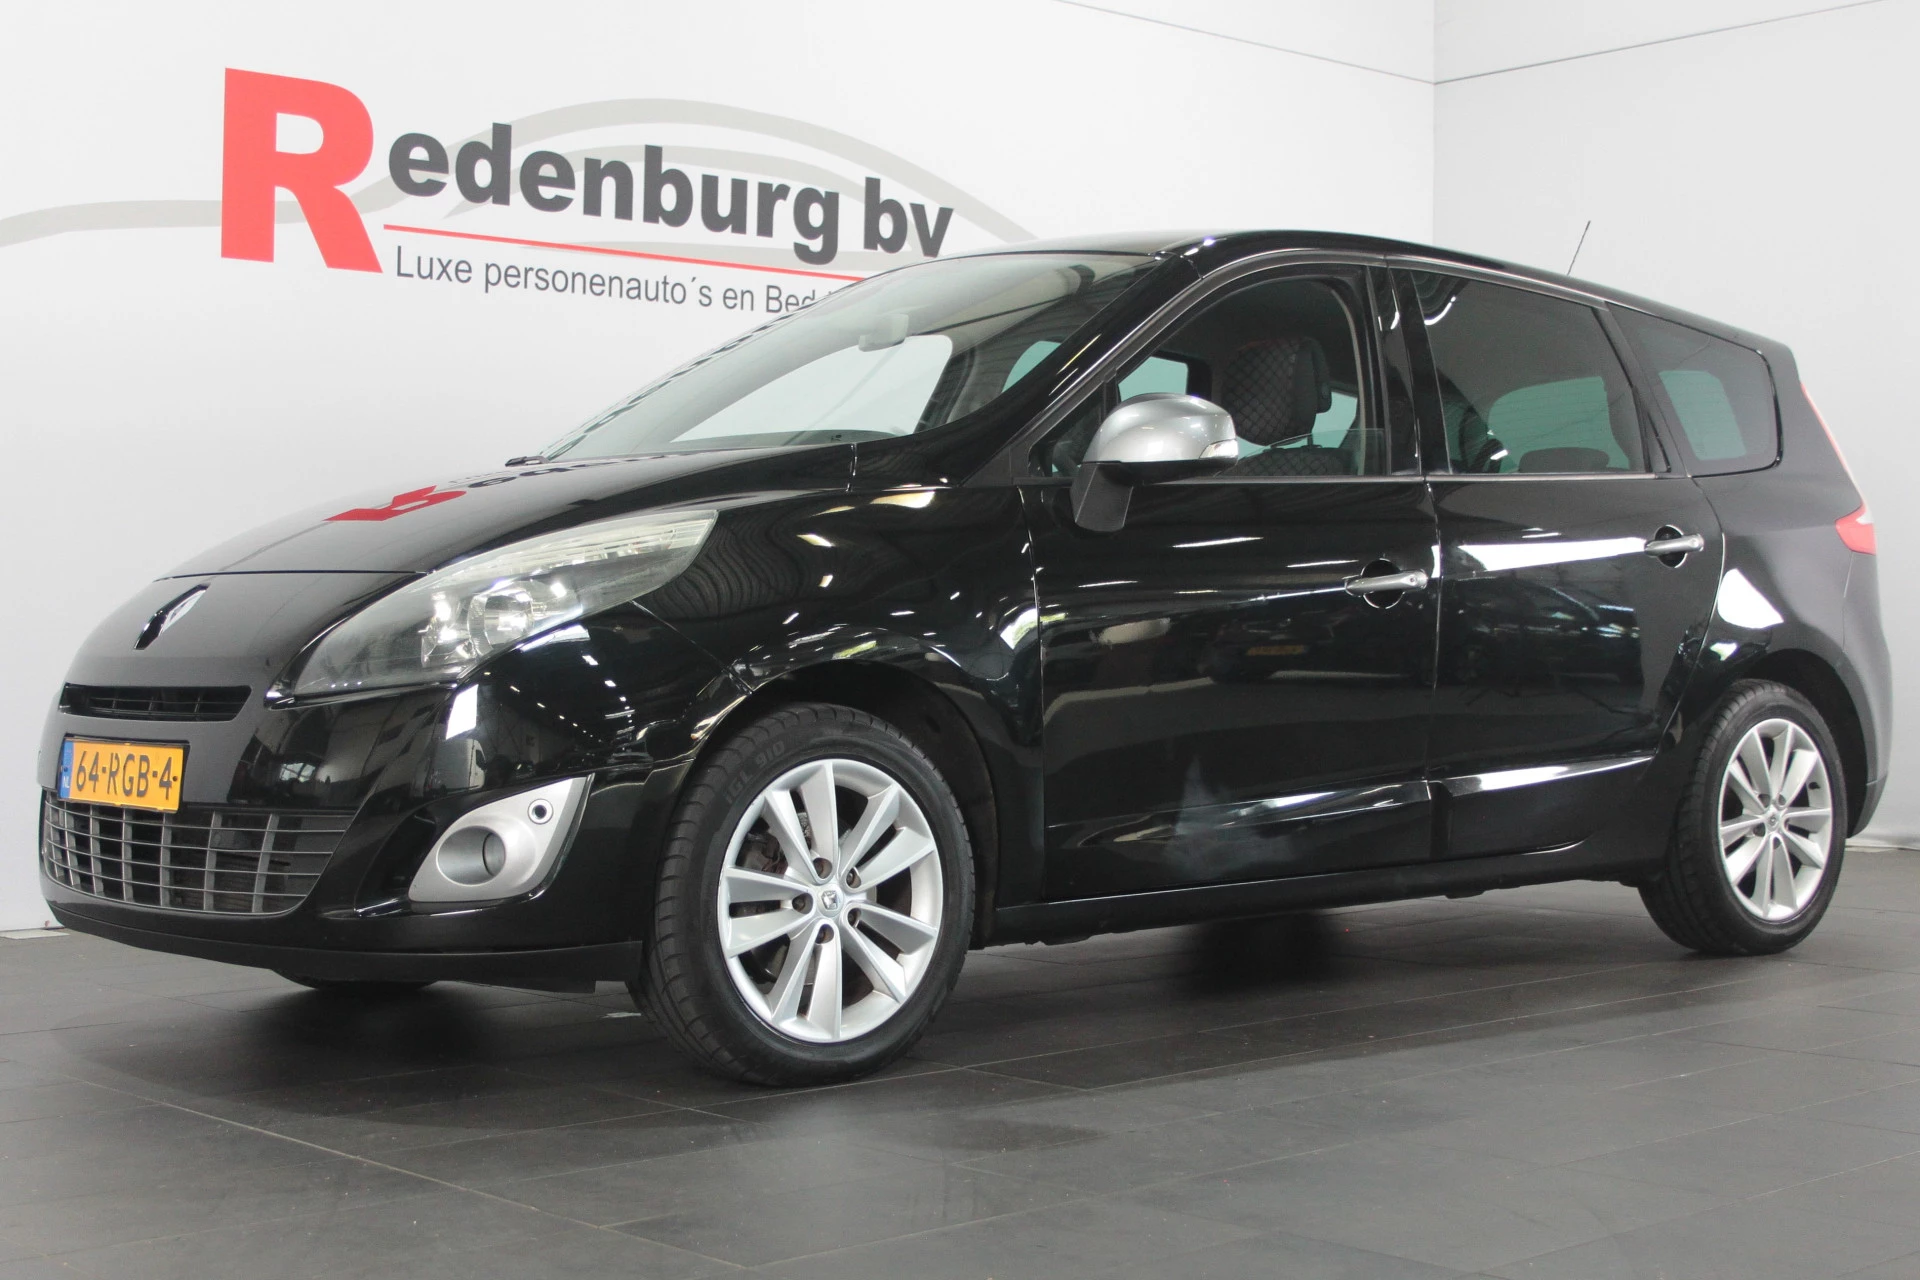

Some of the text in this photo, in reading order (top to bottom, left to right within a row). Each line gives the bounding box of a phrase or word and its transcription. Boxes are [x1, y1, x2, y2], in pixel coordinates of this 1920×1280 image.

[221, 67, 955, 271] Redenburg bv
[396, 245, 473, 284] Luxe
[722, 287, 755, 312] en
[75, 750, 173, 800] 64-RGB-4
